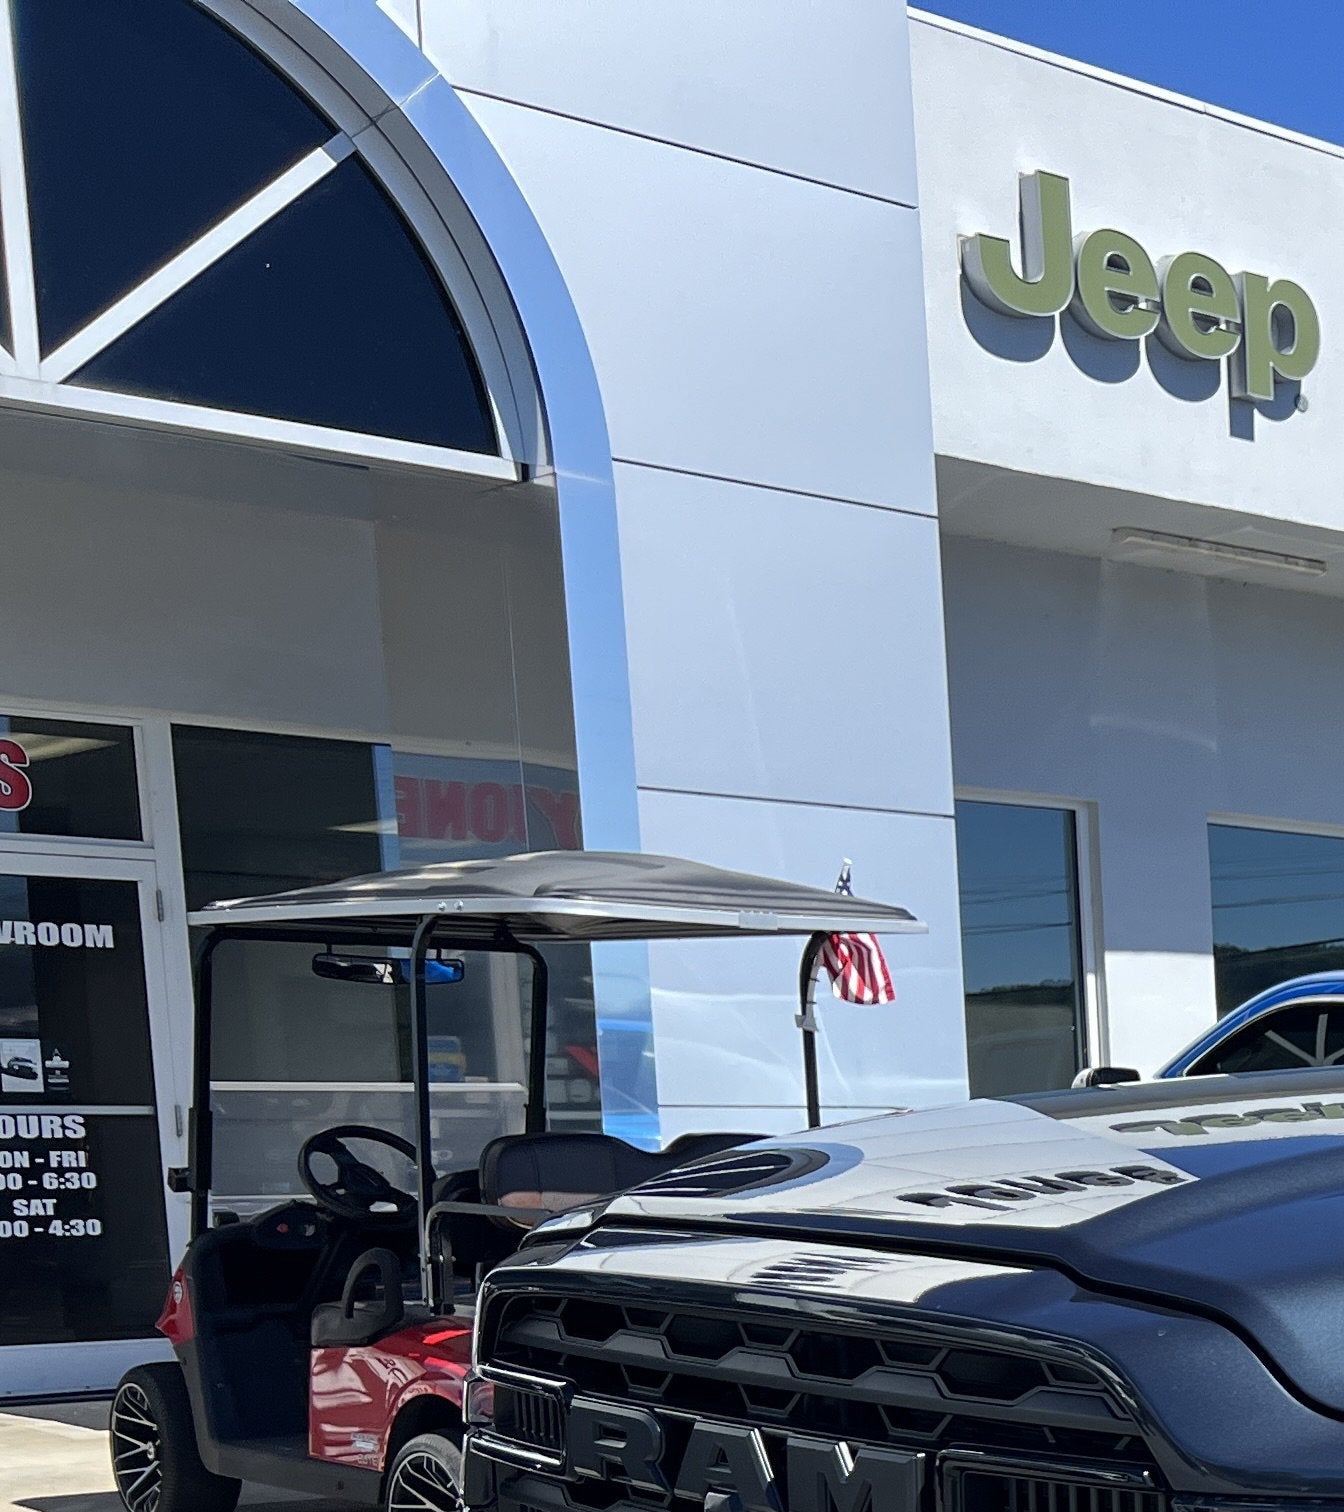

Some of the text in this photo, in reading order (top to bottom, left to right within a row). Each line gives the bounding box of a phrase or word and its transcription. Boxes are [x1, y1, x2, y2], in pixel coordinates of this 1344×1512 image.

[957, 169, 1321, 401] Jeep
[50, 1150, 88, 1168] FRI
[42, 1172, 98, 1190] 6:30
[12, 1198, 57, 1217] SAT
[48, 1218, 103, 1237] 4:30
